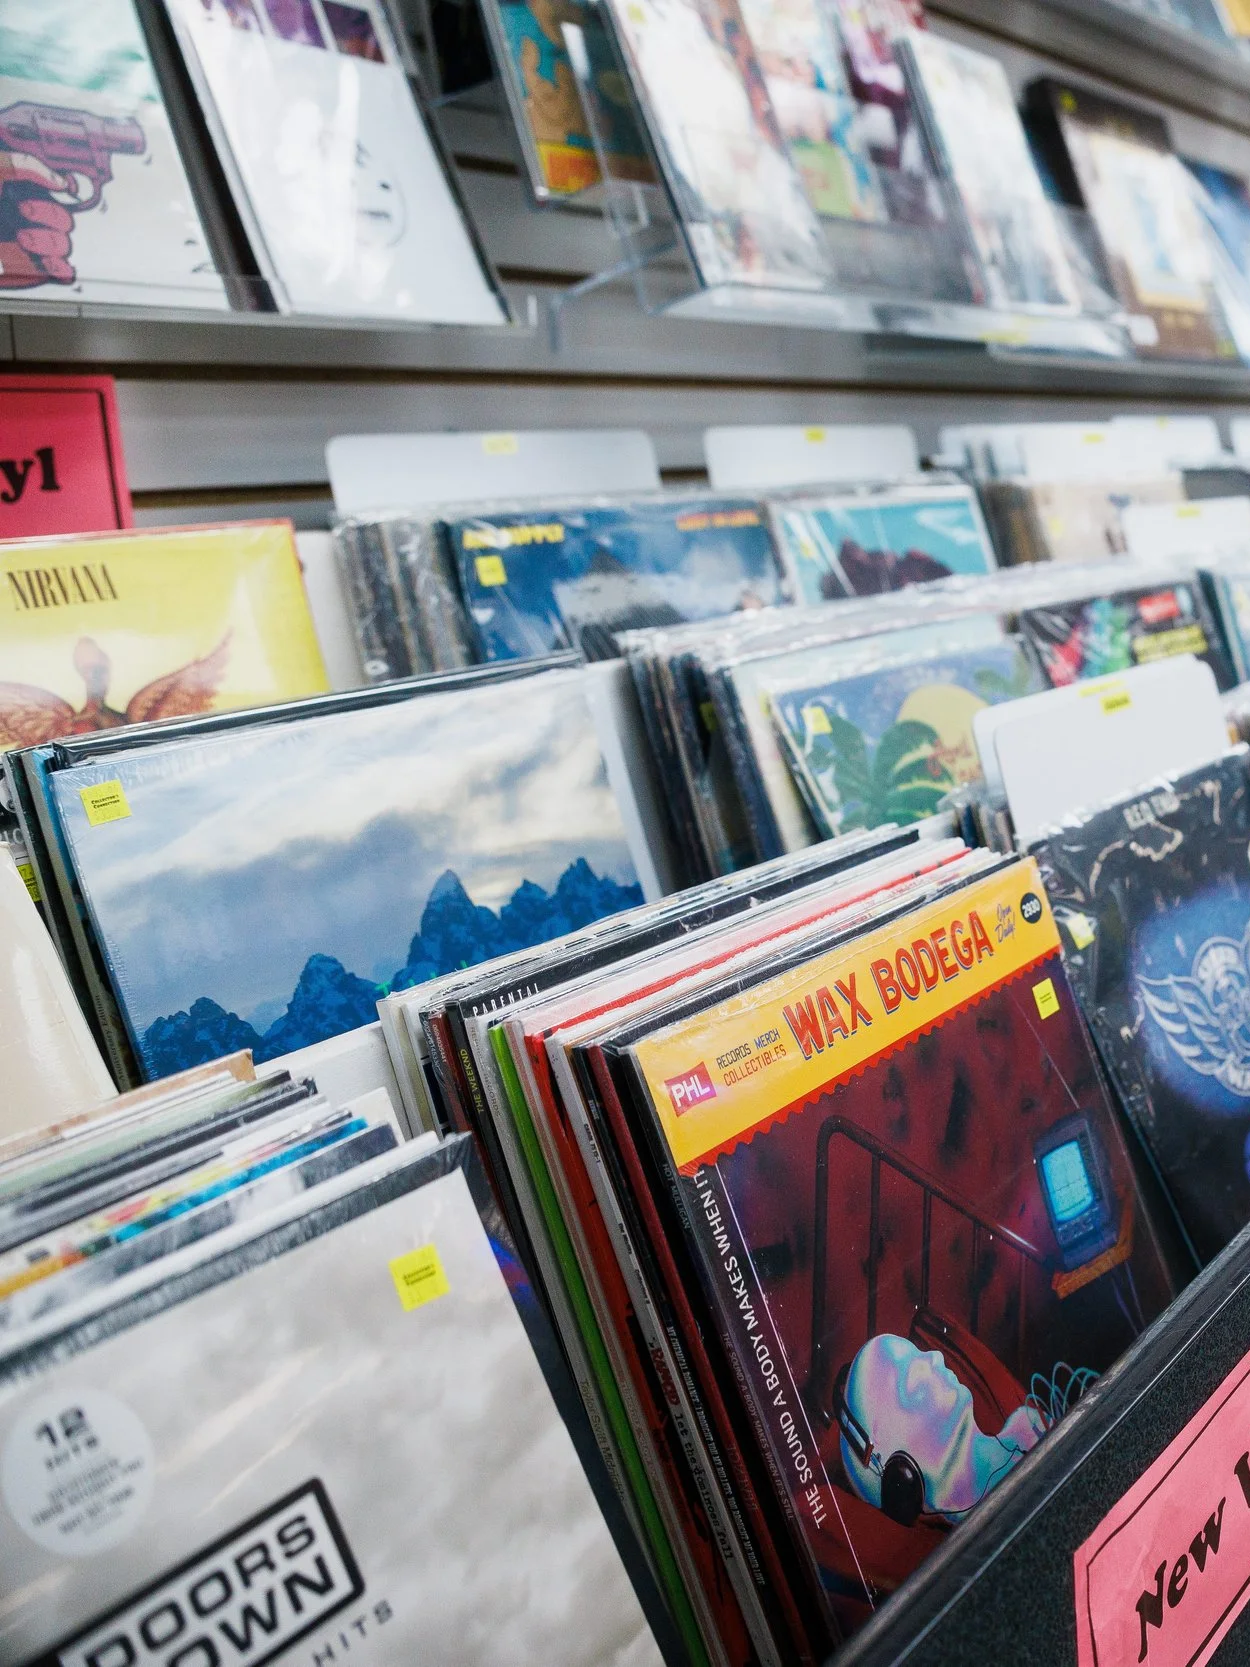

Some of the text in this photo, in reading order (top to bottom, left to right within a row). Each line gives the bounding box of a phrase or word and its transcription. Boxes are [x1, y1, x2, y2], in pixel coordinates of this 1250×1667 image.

[7, 564, 118, 611] NIRVANA
[473, 982, 541, 1017] PARENTAL
[783, 910, 995, 1060] WAX BODEGA
[716, 1028, 780, 1070] RECORDS MERCH
[723, 1044, 787, 1087] COLLECTIBLES
[458, 1047, 484, 1114] THE WEEKND
[671, 1075, 711, 1107] PHL
[661, 1162, 691, 1230] HOT MULLIGAN
[696, 1189, 735, 1256] WHEN
[719, 1255, 762, 1332] MAKES
[719, 1331, 734, 1351] THE
[747, 1330, 783, 1392] BODY
[726, 1350, 746, 1383] SOUND
[577, 1378, 598, 1414] Taylor
[590, 1414, 608, 1445] Swift
[742, 1392, 759, 1418] BODY
[768, 1388, 788, 1408] A
[35, 1405, 89, 1447] 12
[672, 1411, 690, 1437] let
[751, 1419, 770, 1450] MAKES
[682, 1440, 700, 1465] the
[762, 1449, 780, 1478] WHEN
[775, 1410, 816, 1485] SOUND
[689, 1463, 725, 1528] dominoes
[802, 1485, 831, 1530] THE
[715, 1528, 736, 1561] fall
[84, 1514, 317, 1667] DOORS
[1136, 1496, 1226, 1664] New
[167, 1554, 335, 1667] OWN
[312, 1599, 394, 1666] HITS
